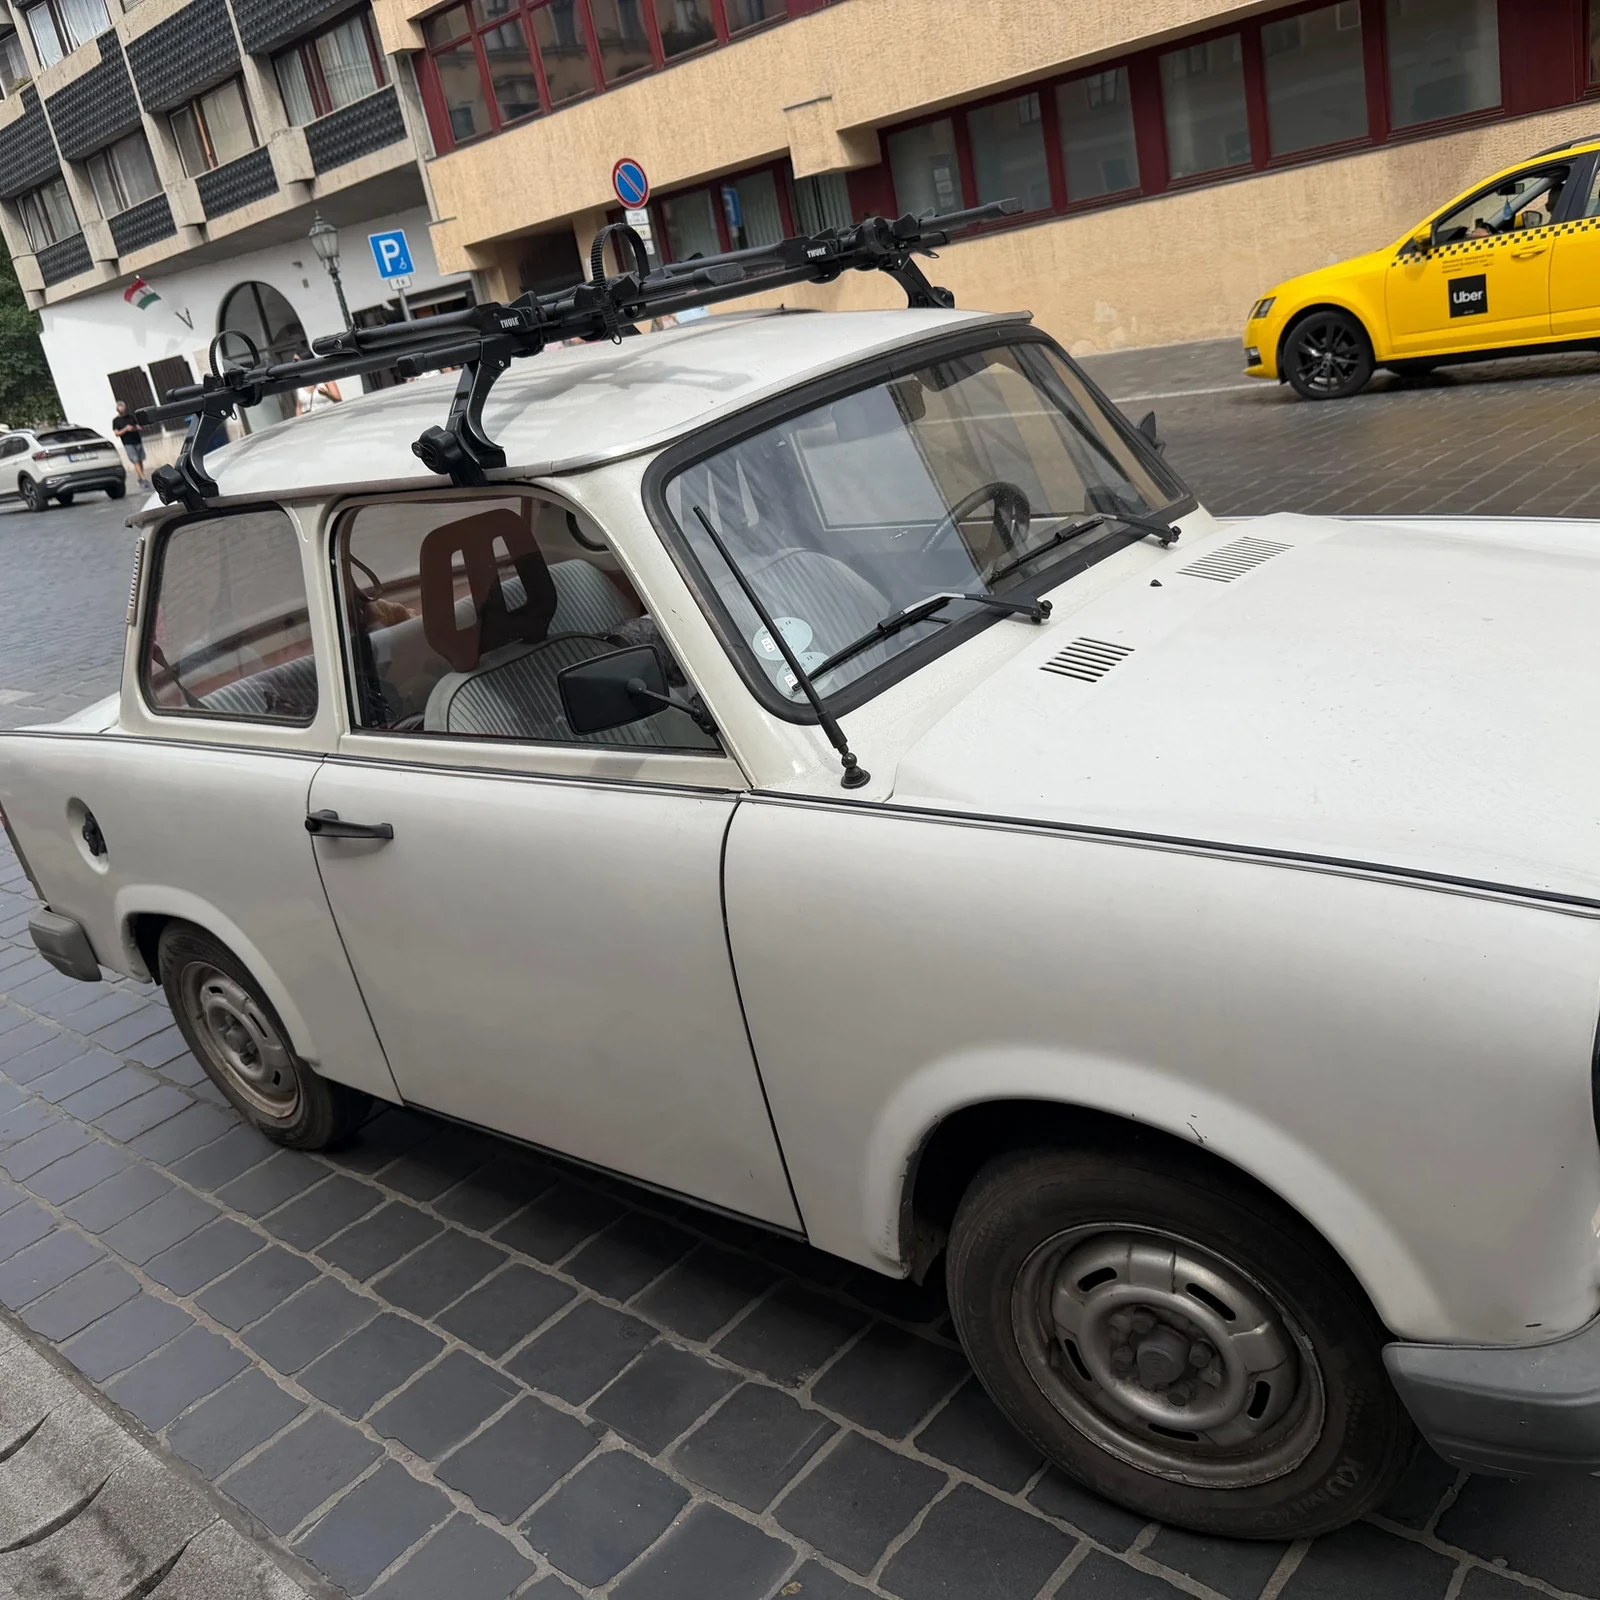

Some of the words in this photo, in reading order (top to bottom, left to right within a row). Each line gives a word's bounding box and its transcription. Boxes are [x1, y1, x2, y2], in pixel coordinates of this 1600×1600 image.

[379, 239, 400, 272] P
[806, 246, 827, 258] THULE
[1452, 290, 1484, 304] Uber
[500, 316, 520, 329] THULE
